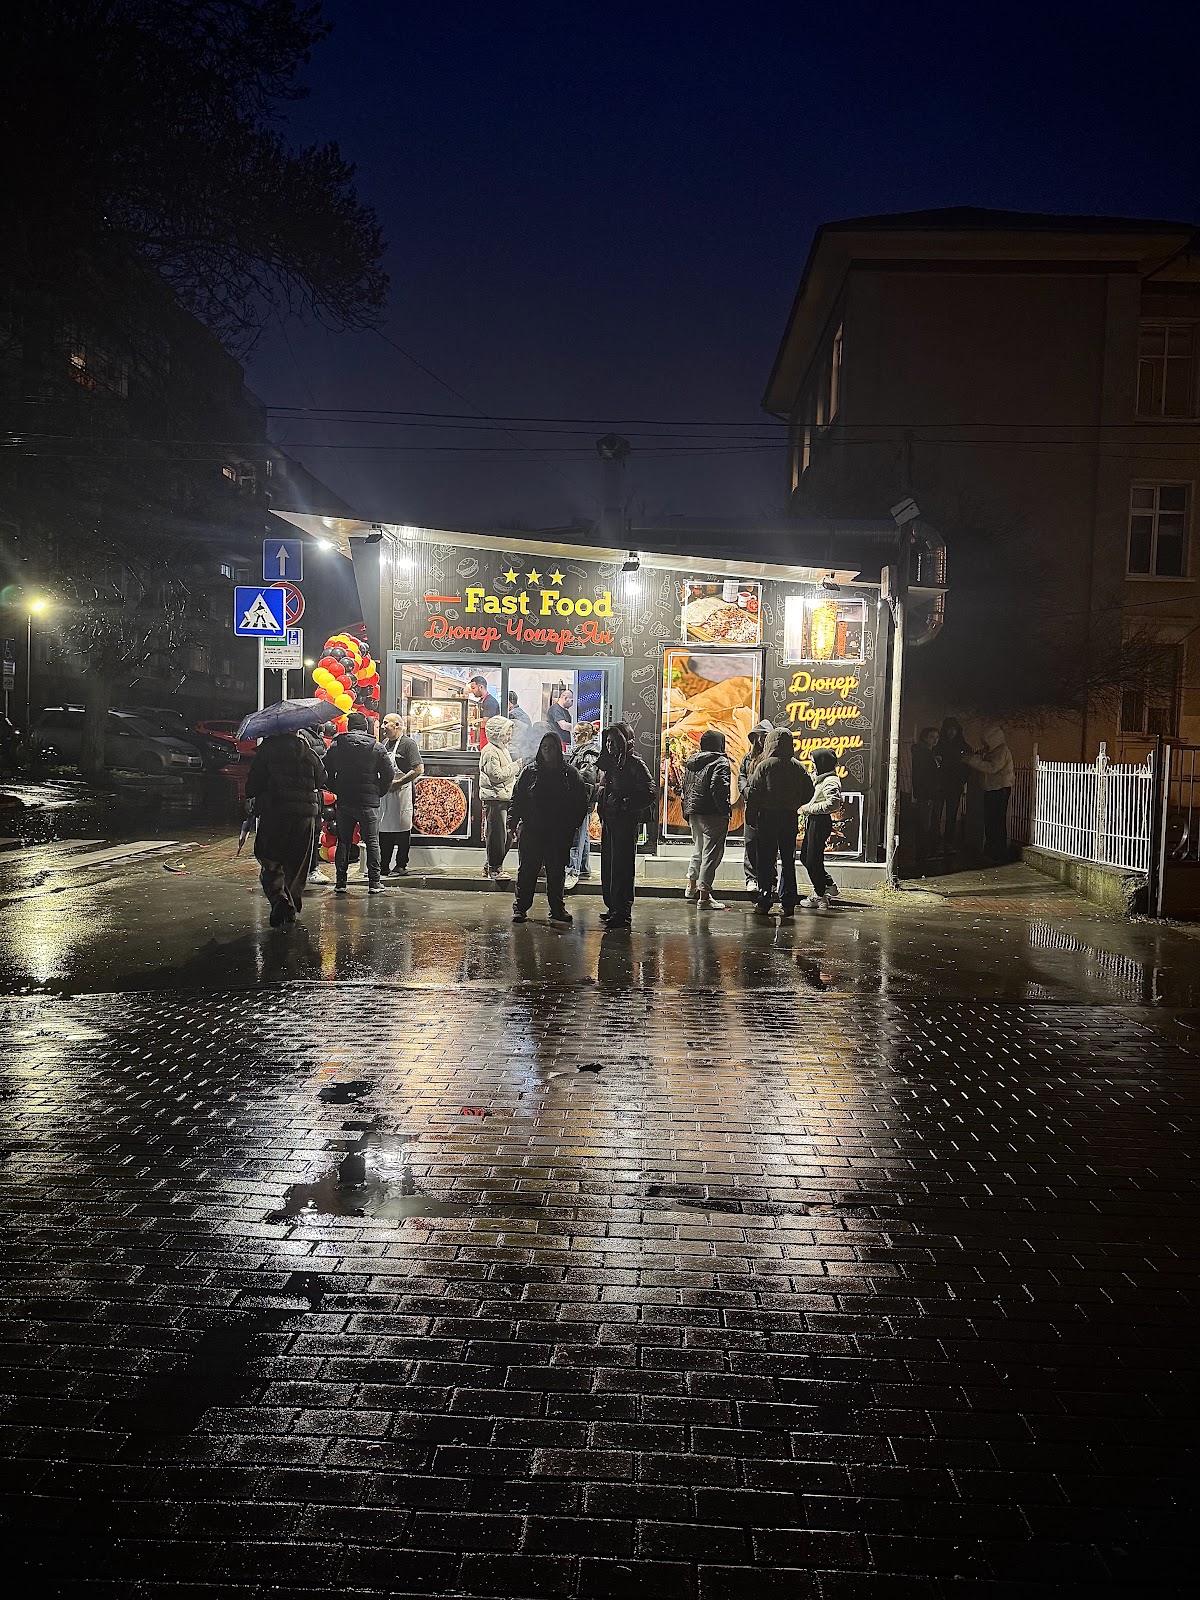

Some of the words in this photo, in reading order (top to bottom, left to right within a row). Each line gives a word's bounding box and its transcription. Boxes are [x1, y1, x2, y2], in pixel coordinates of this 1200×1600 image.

[465, 587, 530, 615] Fast
[539, 589, 614, 617] Food
[424, 615, 501, 651] Дюнер
[506, 618, 575, 653] Чопър
[576, 620, 615, 644] Ян
[788, 671, 859, 699] Дюнер
[785, 701, 861, 730] Порции
